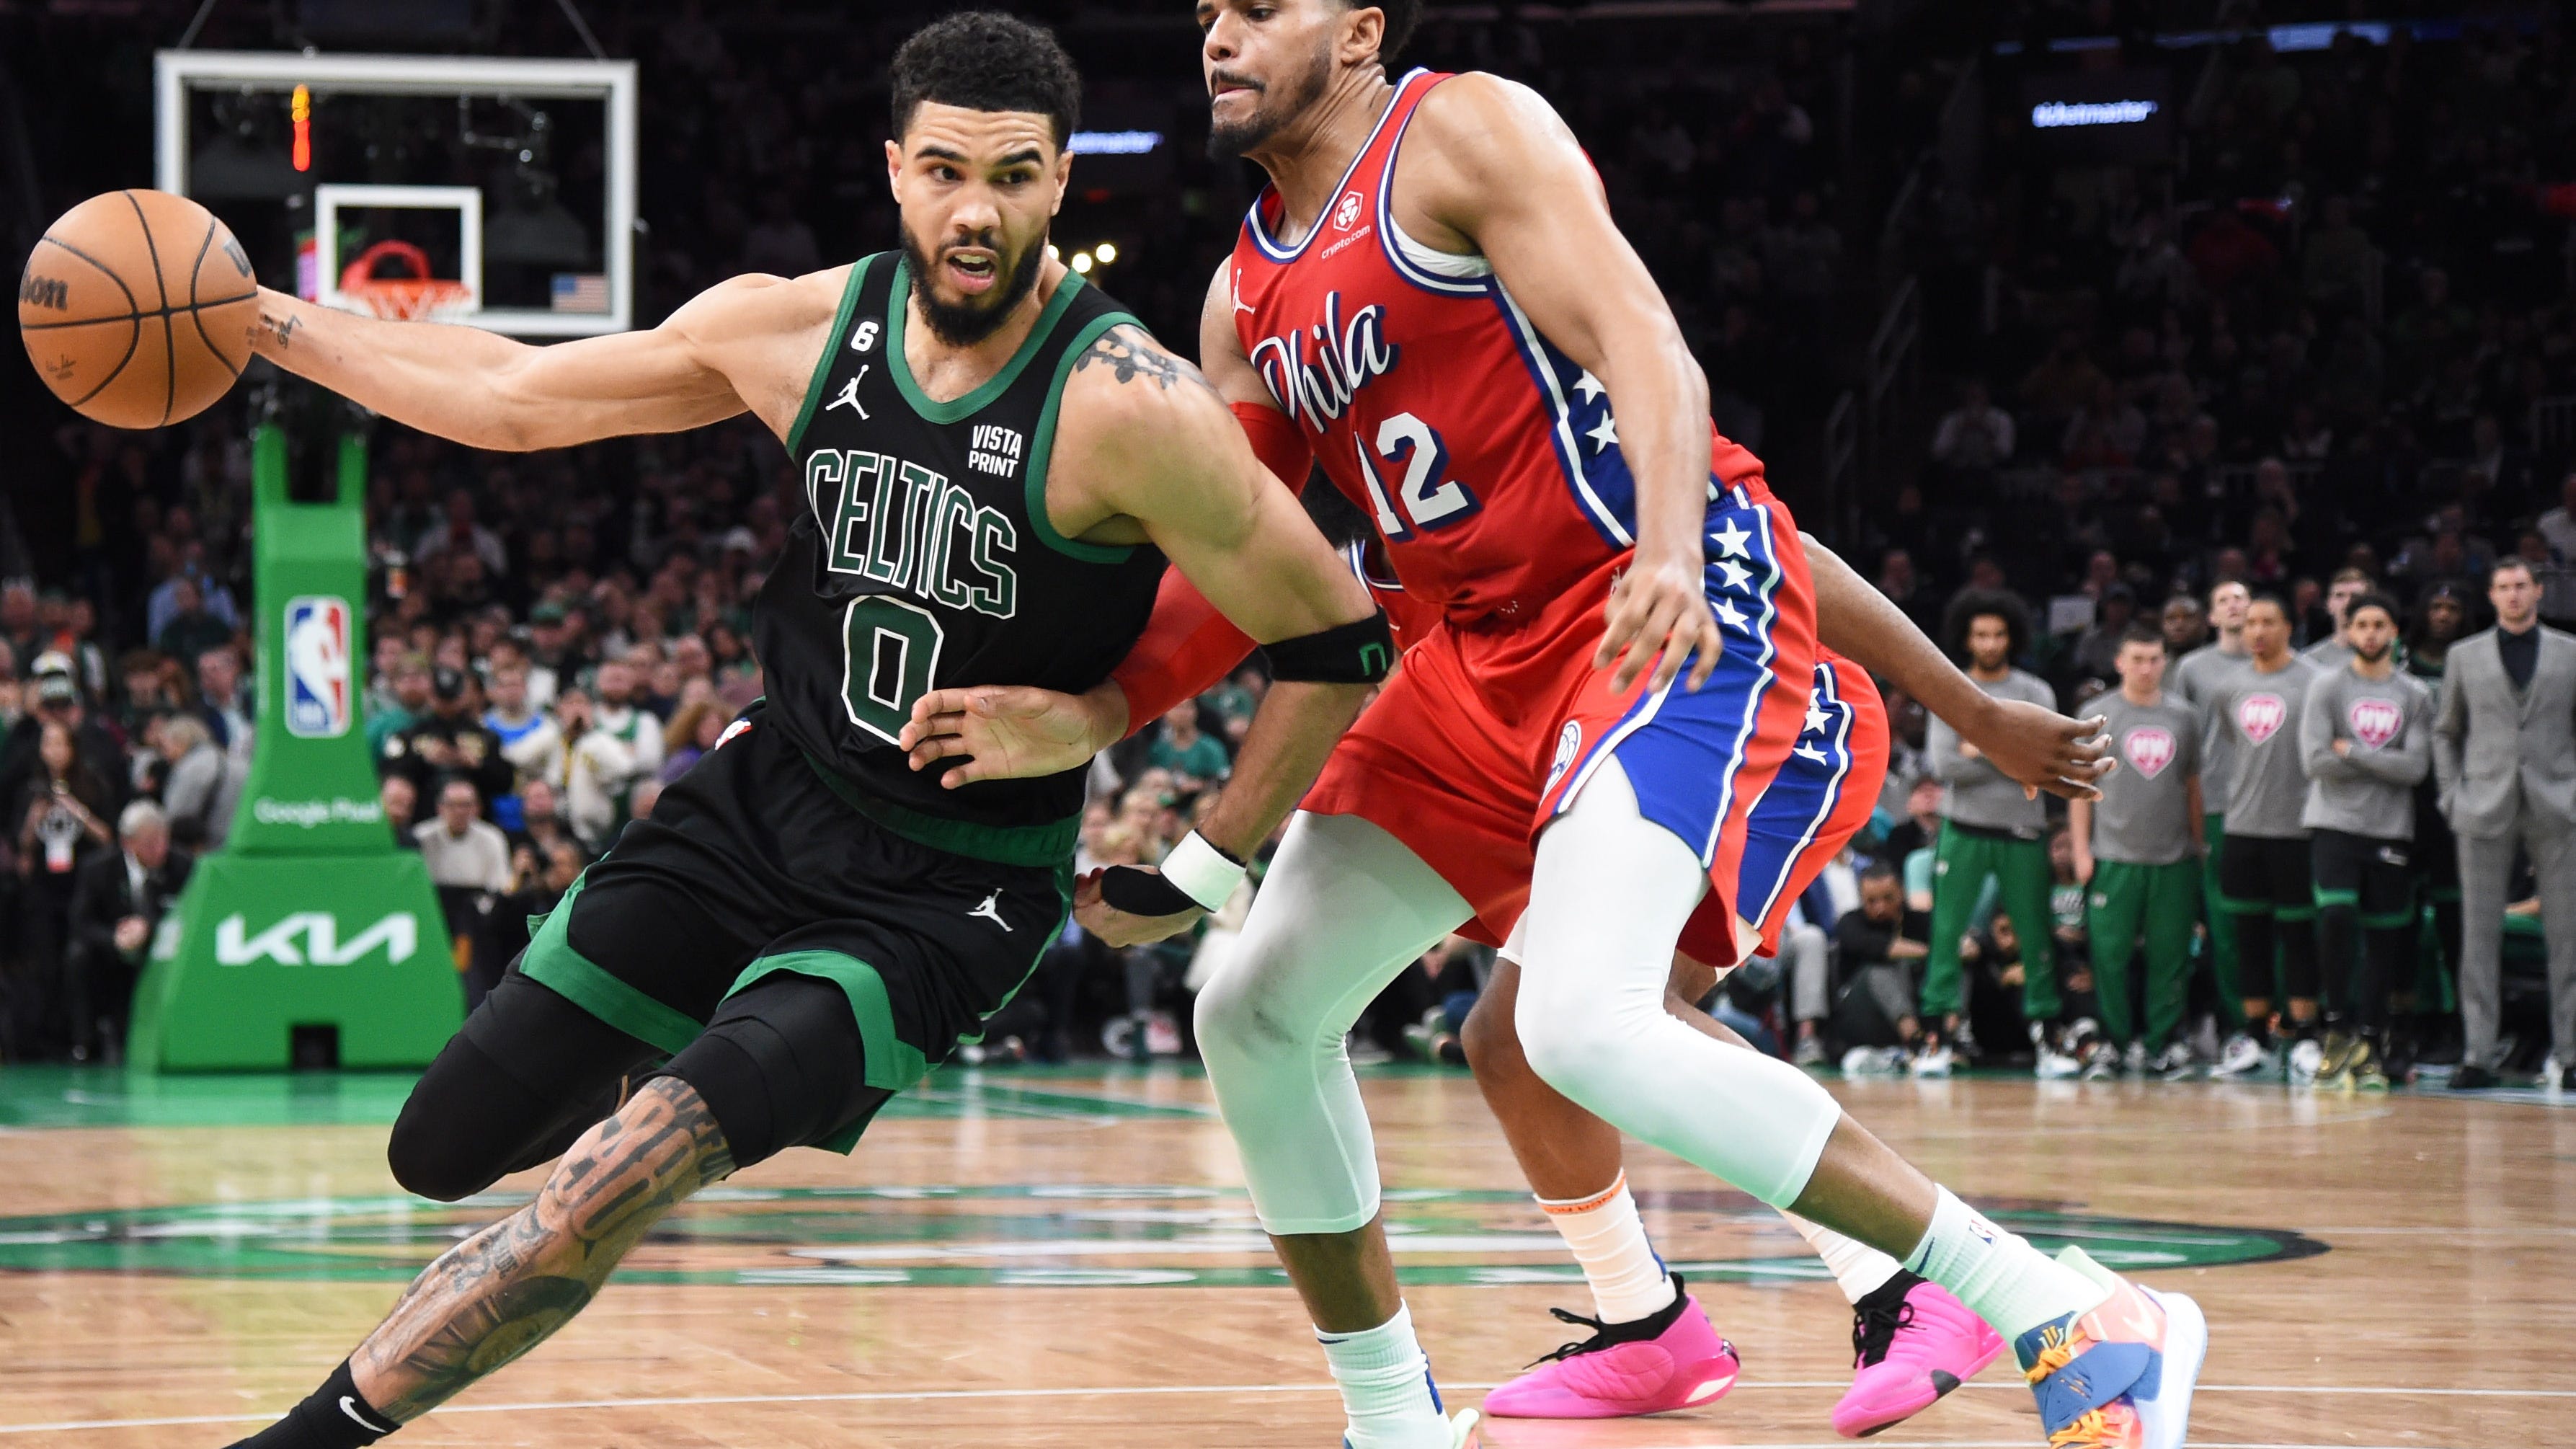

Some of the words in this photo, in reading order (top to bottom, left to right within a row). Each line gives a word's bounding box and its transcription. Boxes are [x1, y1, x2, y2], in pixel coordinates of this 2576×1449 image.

[1321, 225, 1371, 260] crypto.com
[850, 321, 879, 352] 6
[1251, 290, 1400, 434] Phila
[968, 450, 1018, 478] PRINT
[972, 425, 1023, 459] VISTA
[1353, 412, 1479, 541] 12
[806, 448, 1017, 620] CELTICS
[841, 595, 944, 745] 0
